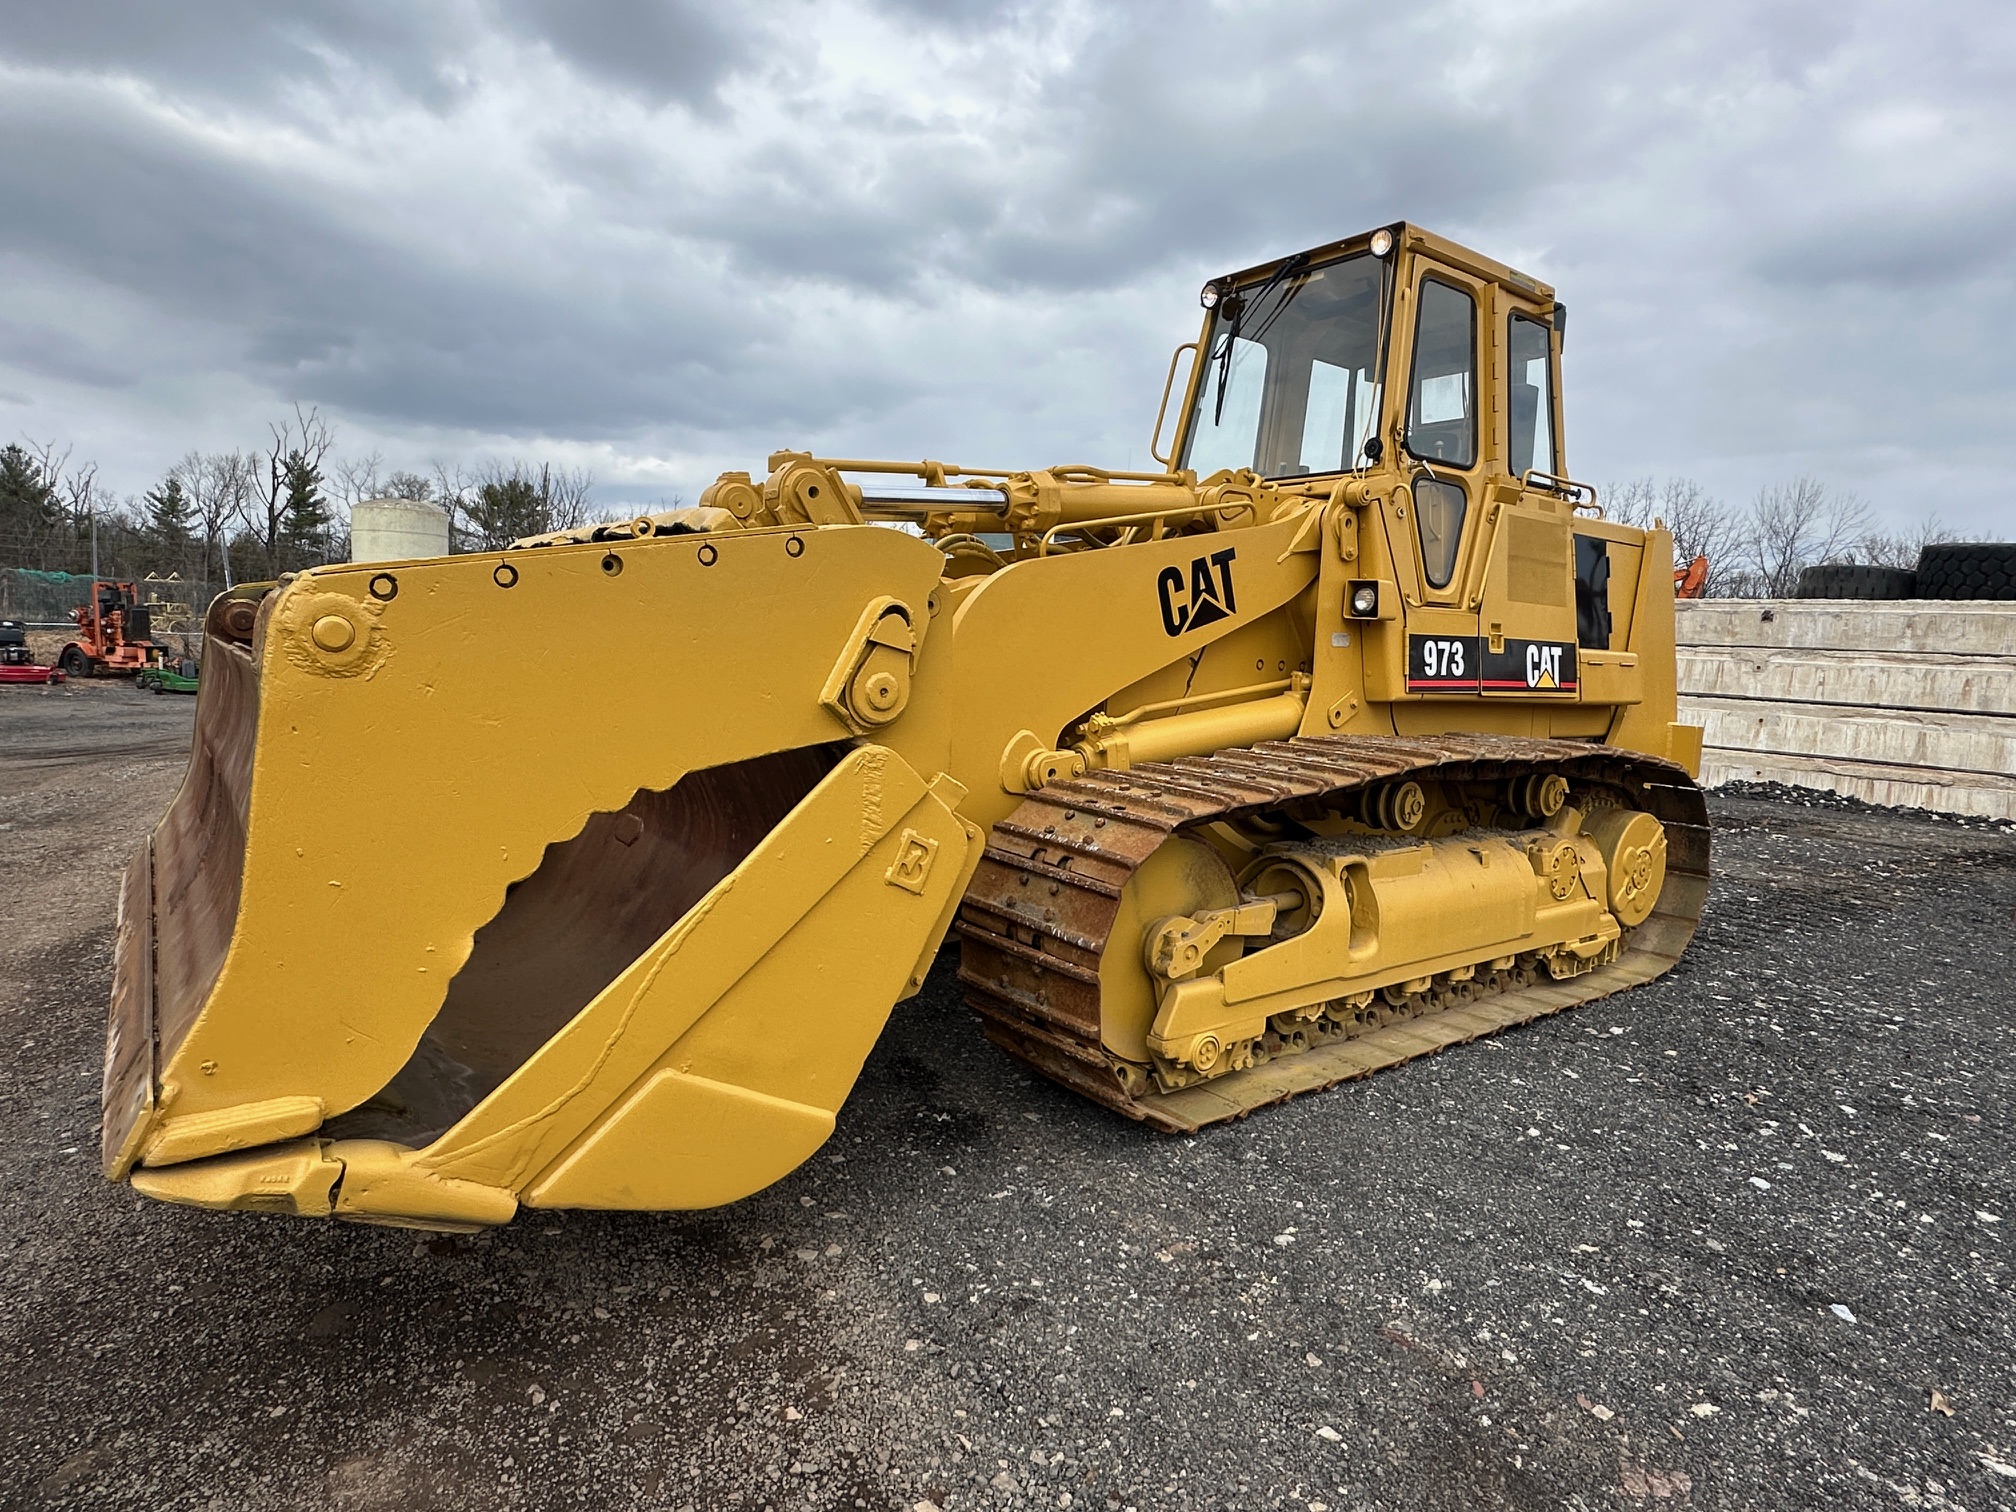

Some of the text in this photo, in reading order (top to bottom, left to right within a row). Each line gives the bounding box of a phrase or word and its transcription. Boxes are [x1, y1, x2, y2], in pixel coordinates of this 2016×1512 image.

[1157, 546, 1236, 637] CAT
[1423, 640, 1465, 677] 973
[1526, 644, 1563, 688] CAT
